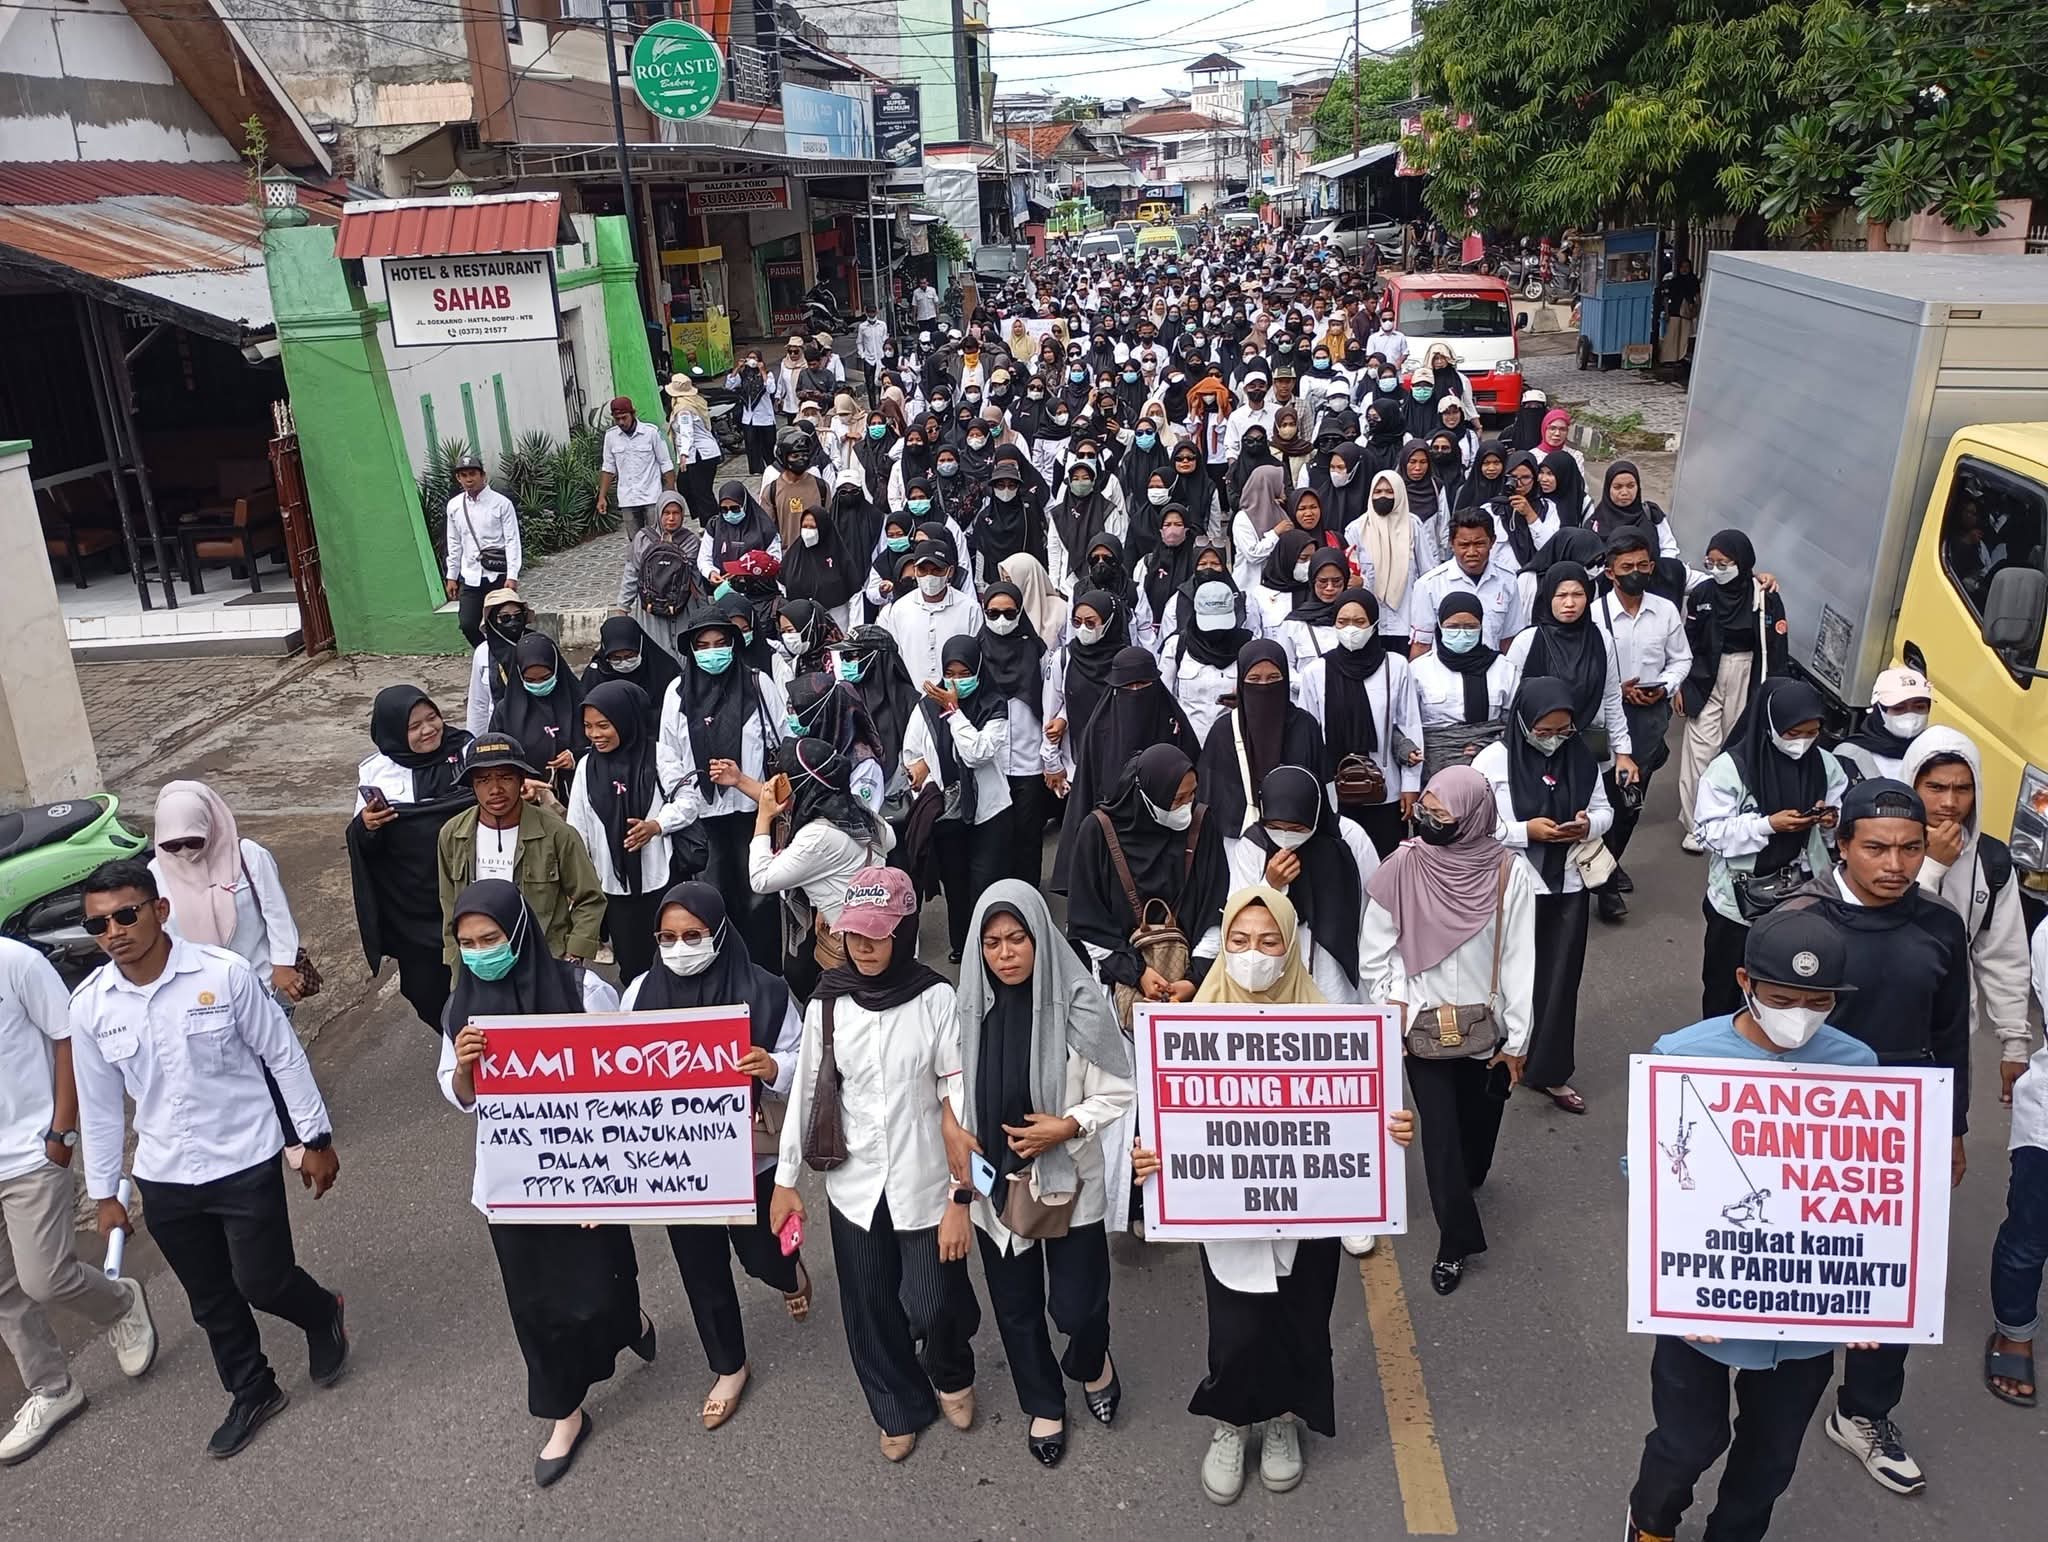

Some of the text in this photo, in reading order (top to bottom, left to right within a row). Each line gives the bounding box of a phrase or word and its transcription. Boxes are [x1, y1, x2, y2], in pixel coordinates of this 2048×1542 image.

[636, 58, 717, 80] ROCASTE
[660, 78, 695, 88] Bakery
[698, 190, 776, 206] SURABAYA
[705, 182, 732, 190] SALON
[744, 180, 768, 188] TOKO
[391, 260, 543, 282] HOTEL & RESTAURANT
[433, 285, 512, 312] SAHAB
[428, 318, 463, 326] SOEKARNO
[458, 326, 508, 336] (0373) 21577
[480, 1039, 741, 1082] KAMI KORBAN
[1163, 1032, 1369, 1062] PAK PRESIDEN
[1165, 1075, 1370, 1107] TOLONG KAMI
[1709, 1082, 1907, 1121] JANGAN
[478, 1094, 745, 1121] KELALAIAN PEMKAB DOMPU
[540, 1126, 594, 1146] TIDAK
[602, 1122, 738, 1144] DIAJUKANNYA
[1206, 1120, 1331, 1147] HONORER
[1732, 1119, 1906, 1164] GANTUNG
[538, 1150, 692, 1171] DALAM SKEMA
[1171, 1152, 1371, 1179] NON DATA BASE
[523, 1174, 709, 1198] PPPK PARUH WAKTU
[1781, 1163, 1905, 1195] NASIB
[1244, 1186, 1298, 1212] BKN
[1801, 1195, 1903, 1226] KAMI
[1705, 1228, 1864, 1257] angkat kami
[1661, 1251, 1907, 1288] PPPK PARUH WAKTU
[1696, 1287, 1871, 1315] secepatnya!!!
